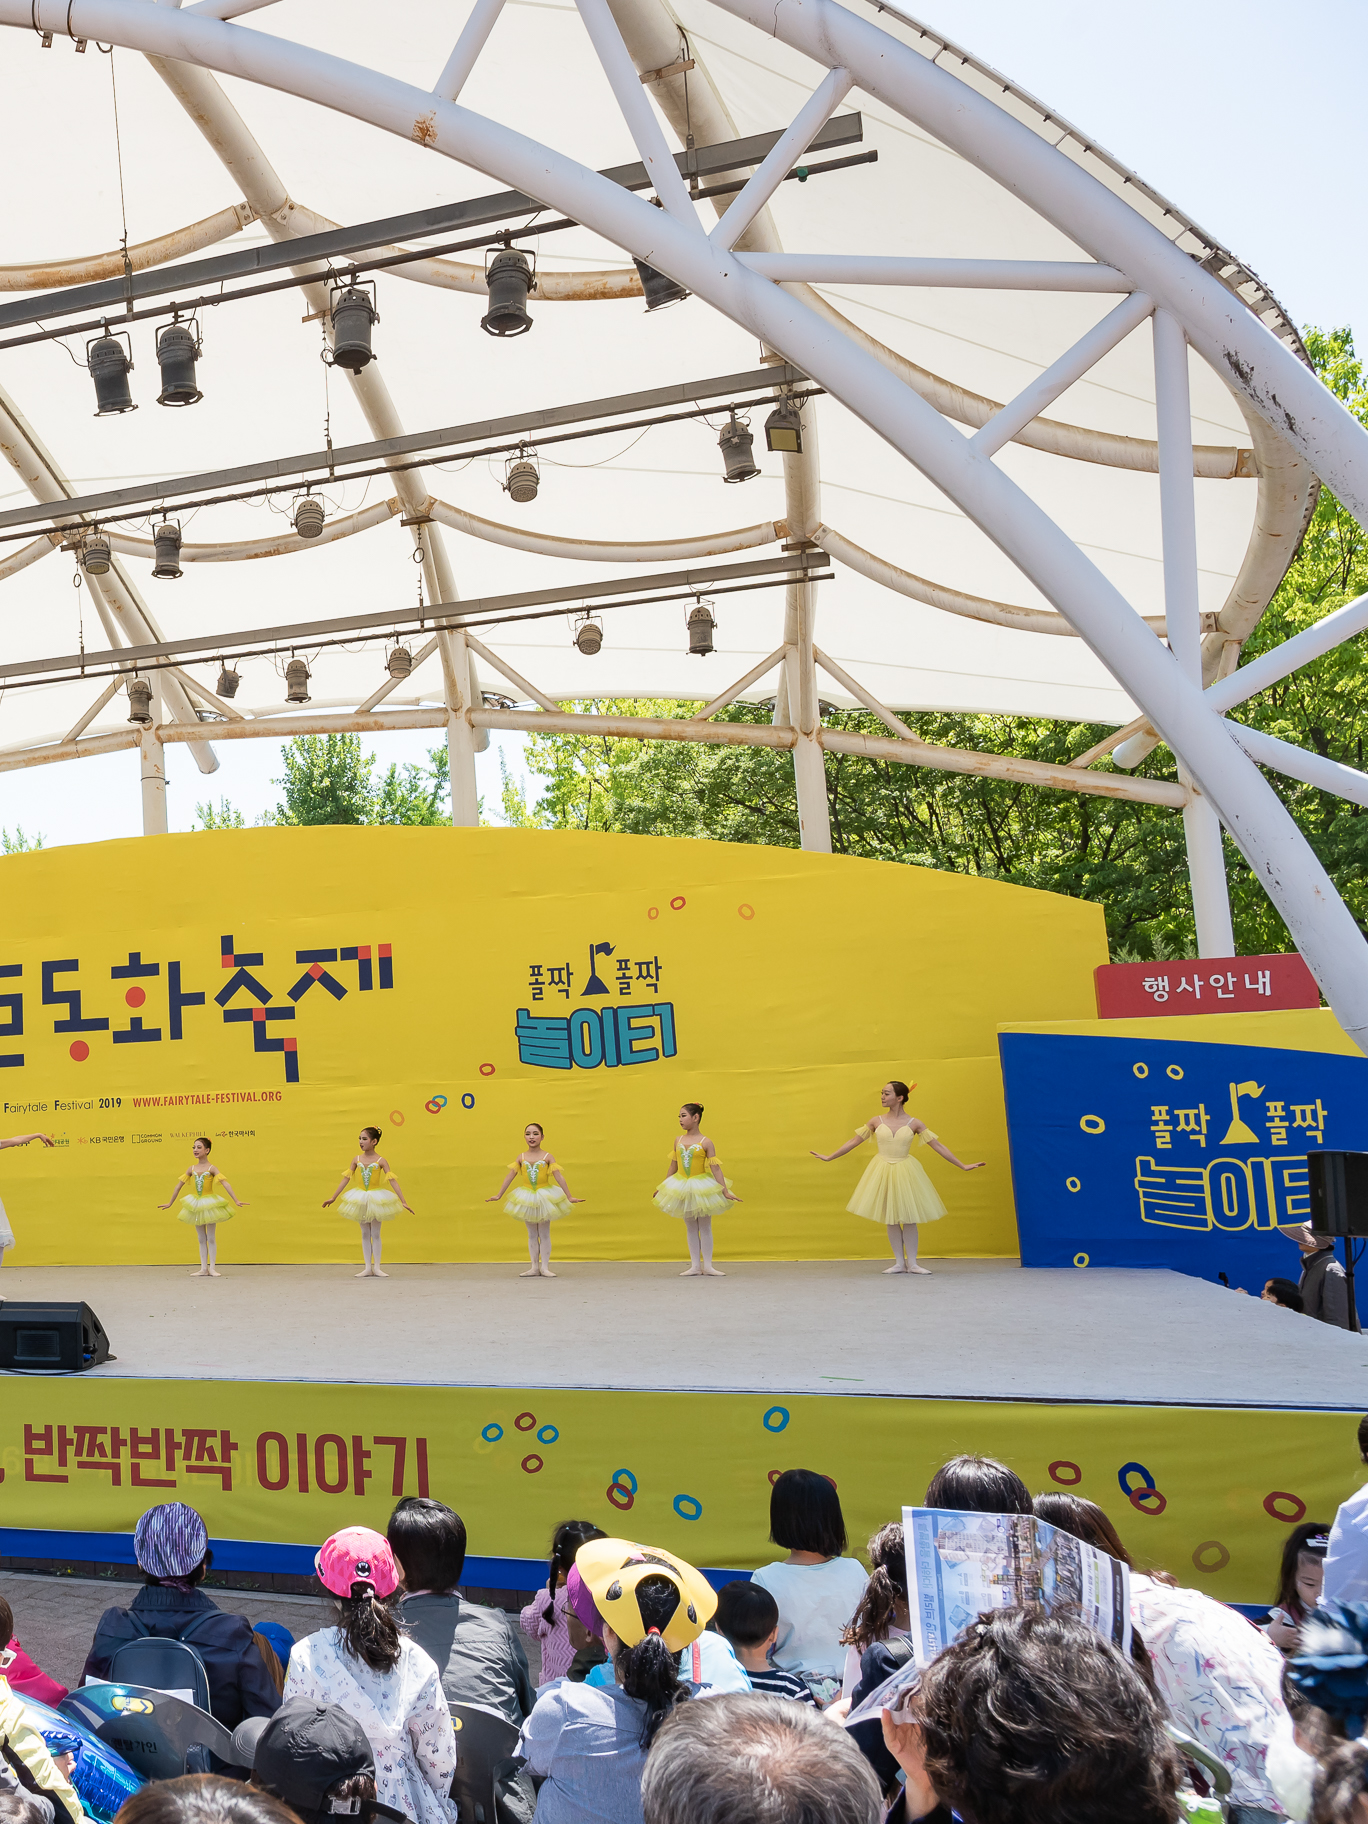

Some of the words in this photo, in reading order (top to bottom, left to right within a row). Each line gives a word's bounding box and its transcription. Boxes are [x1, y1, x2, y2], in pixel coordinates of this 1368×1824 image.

[529, 962, 573, 1001] 폴짝
[616, 956, 662, 995] 폴짝
[1143, 970, 1271, 1002] 행사안내
[515, 1002, 677, 1070] 놀이터
[4, 1102, 48, 1114] Fairytale
[55, 1100, 94, 1111] Festival
[99, 1097, 122, 1109] 2019
[133, 1090, 283, 1108] WWW.FAIRYTALE-FESTIVAL.ORG
[1150, 1103, 1211, 1149] 폴짝
[1265, 1098, 1328, 1146] 폴짝
[23, 1423, 239, 1492] 반짝반짝
[256, 1431, 430, 1498] 이야기
